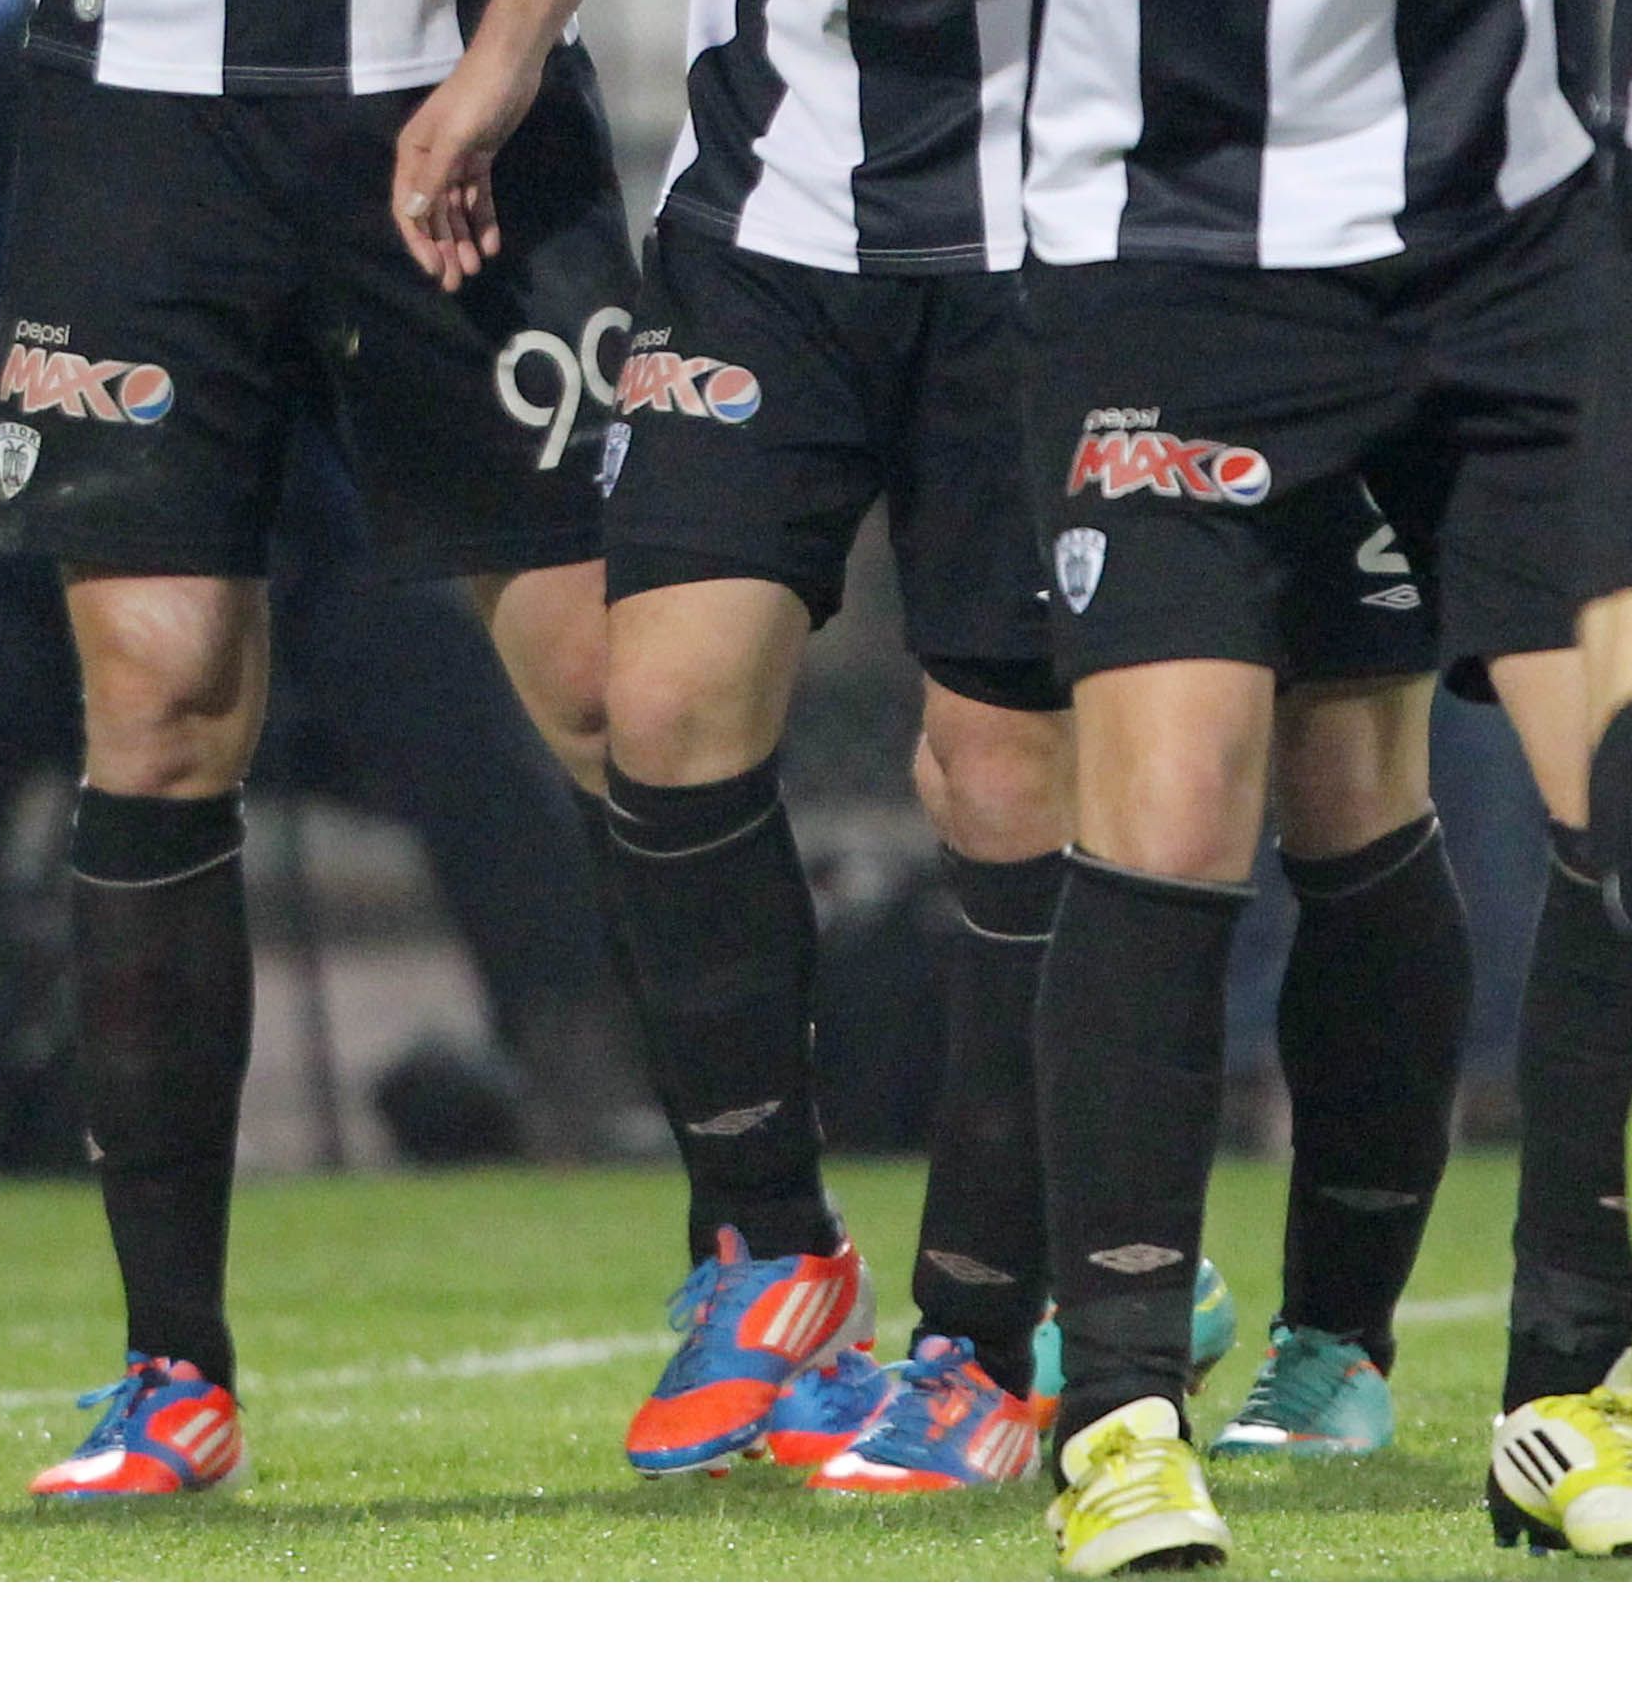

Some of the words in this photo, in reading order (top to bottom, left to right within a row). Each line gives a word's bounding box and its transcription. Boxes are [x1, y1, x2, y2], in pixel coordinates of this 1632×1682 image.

[15, 319, 71, 346] pepsi
[0, 343, 134, 422] MAX
[1068, 430, 1224, 502] MAX
